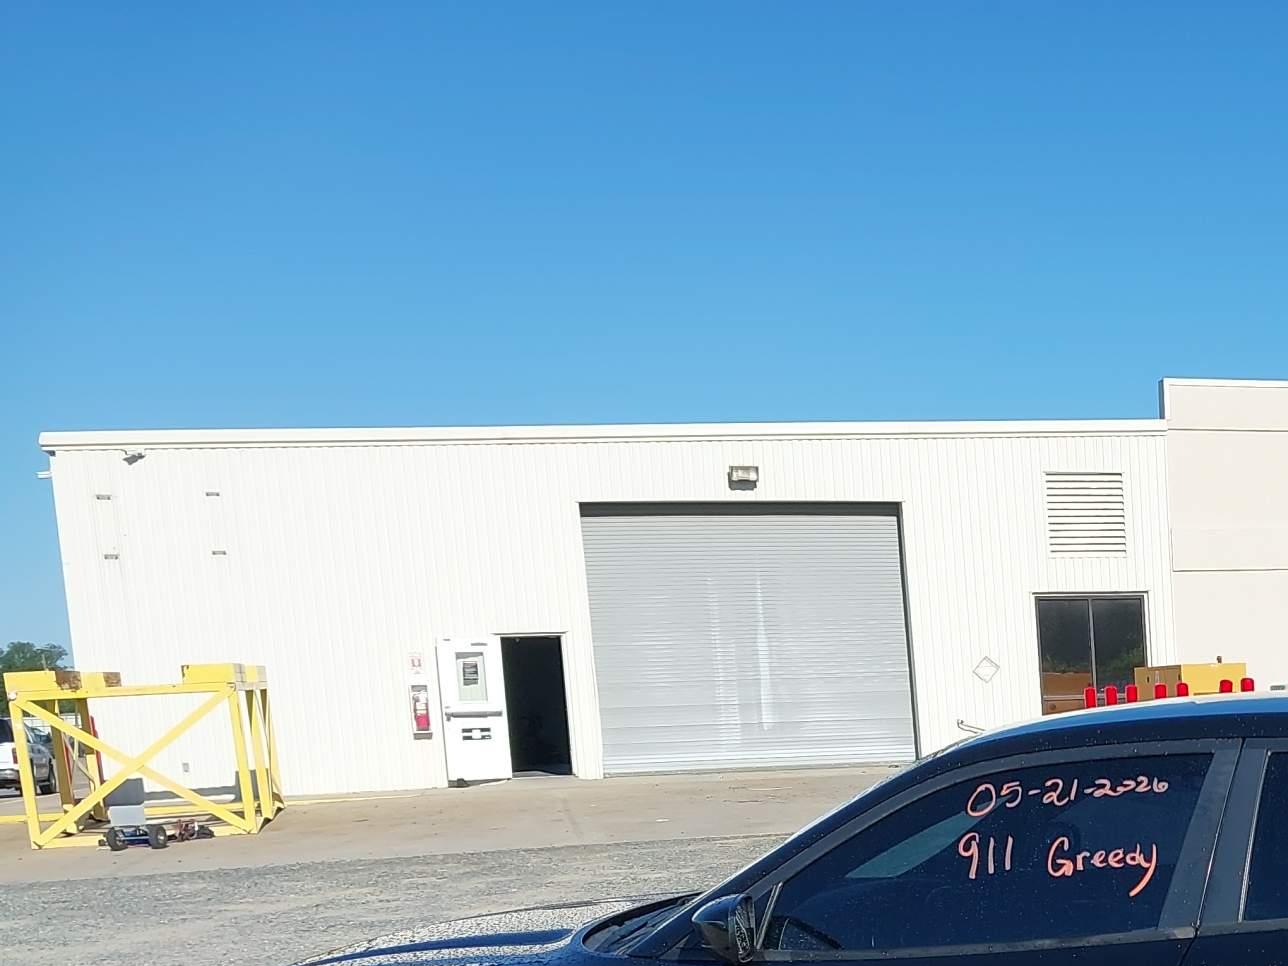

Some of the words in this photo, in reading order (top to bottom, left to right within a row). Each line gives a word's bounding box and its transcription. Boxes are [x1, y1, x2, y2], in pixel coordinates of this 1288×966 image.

[966, 775, 1169, 817] 05-21-2026
[958, 831, 1013, 880] 911
[1047, 836, 1157, 897] Greedy
